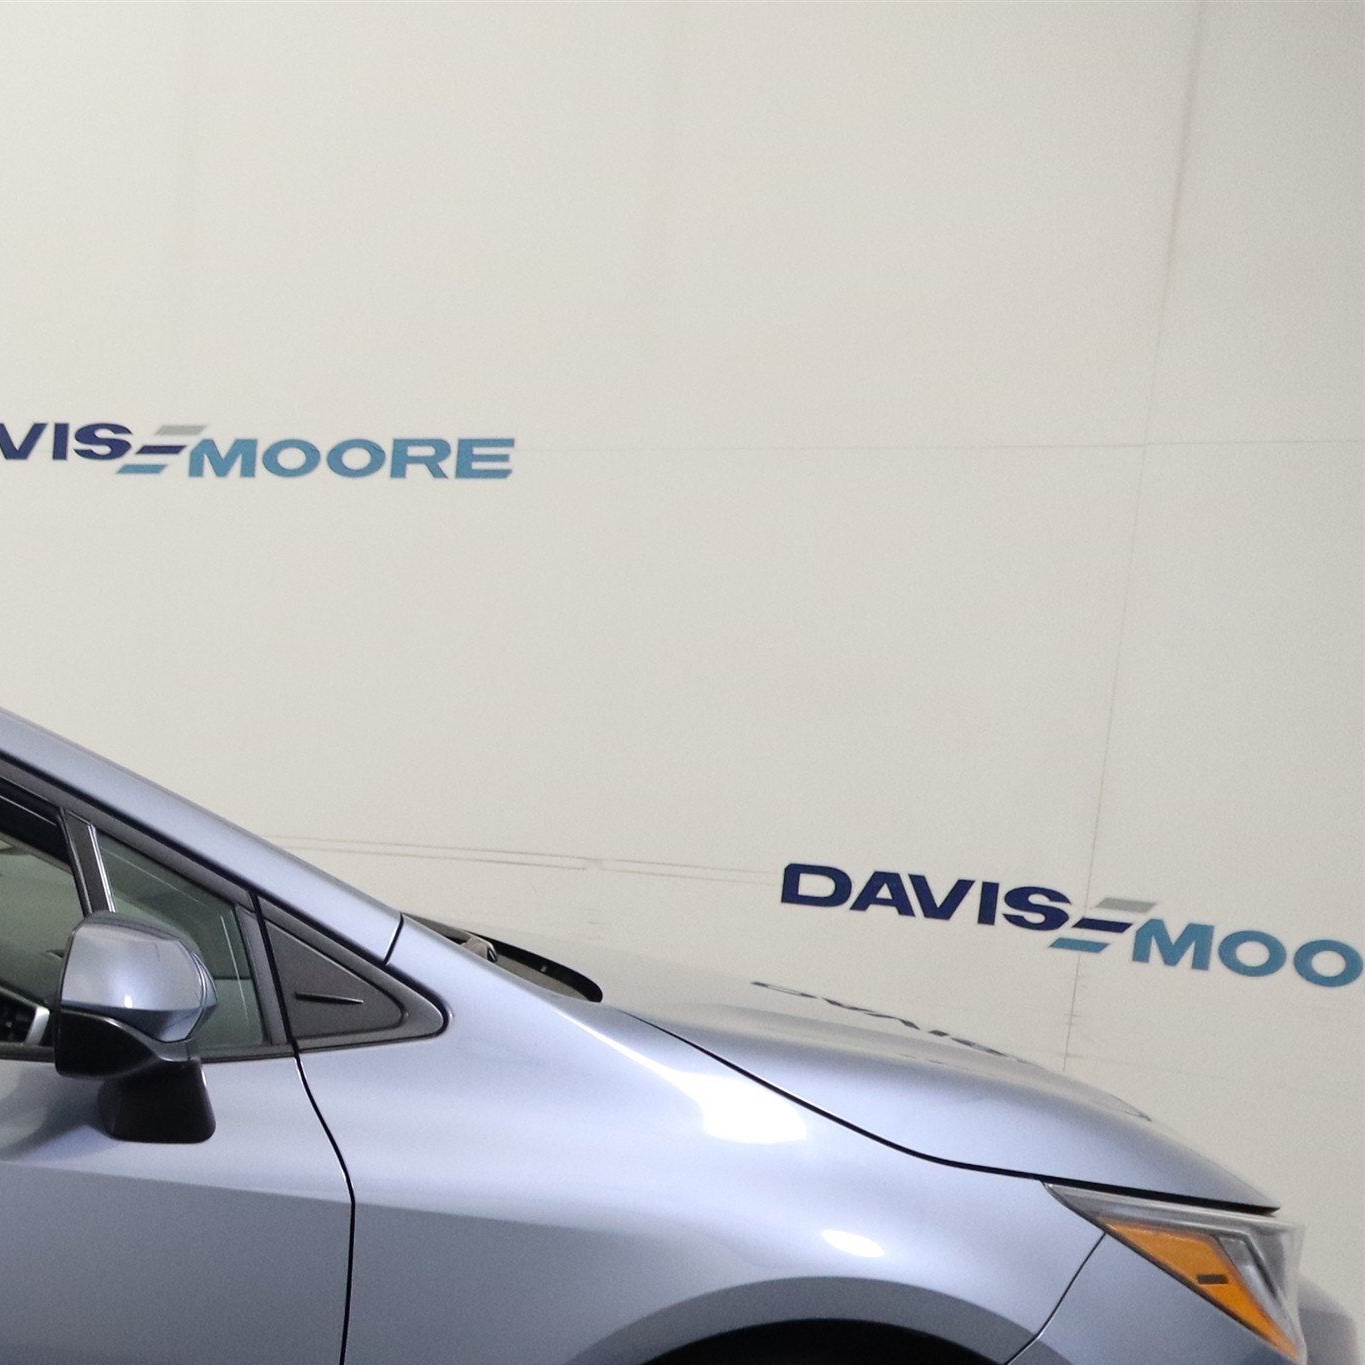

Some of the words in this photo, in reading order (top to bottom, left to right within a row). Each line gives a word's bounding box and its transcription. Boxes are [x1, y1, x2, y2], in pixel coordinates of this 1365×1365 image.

[187, 437, 516, 479] MOORE
[779, 862, 1073, 932] DAVIS
[1131, 917, 1364, 988] MOO
